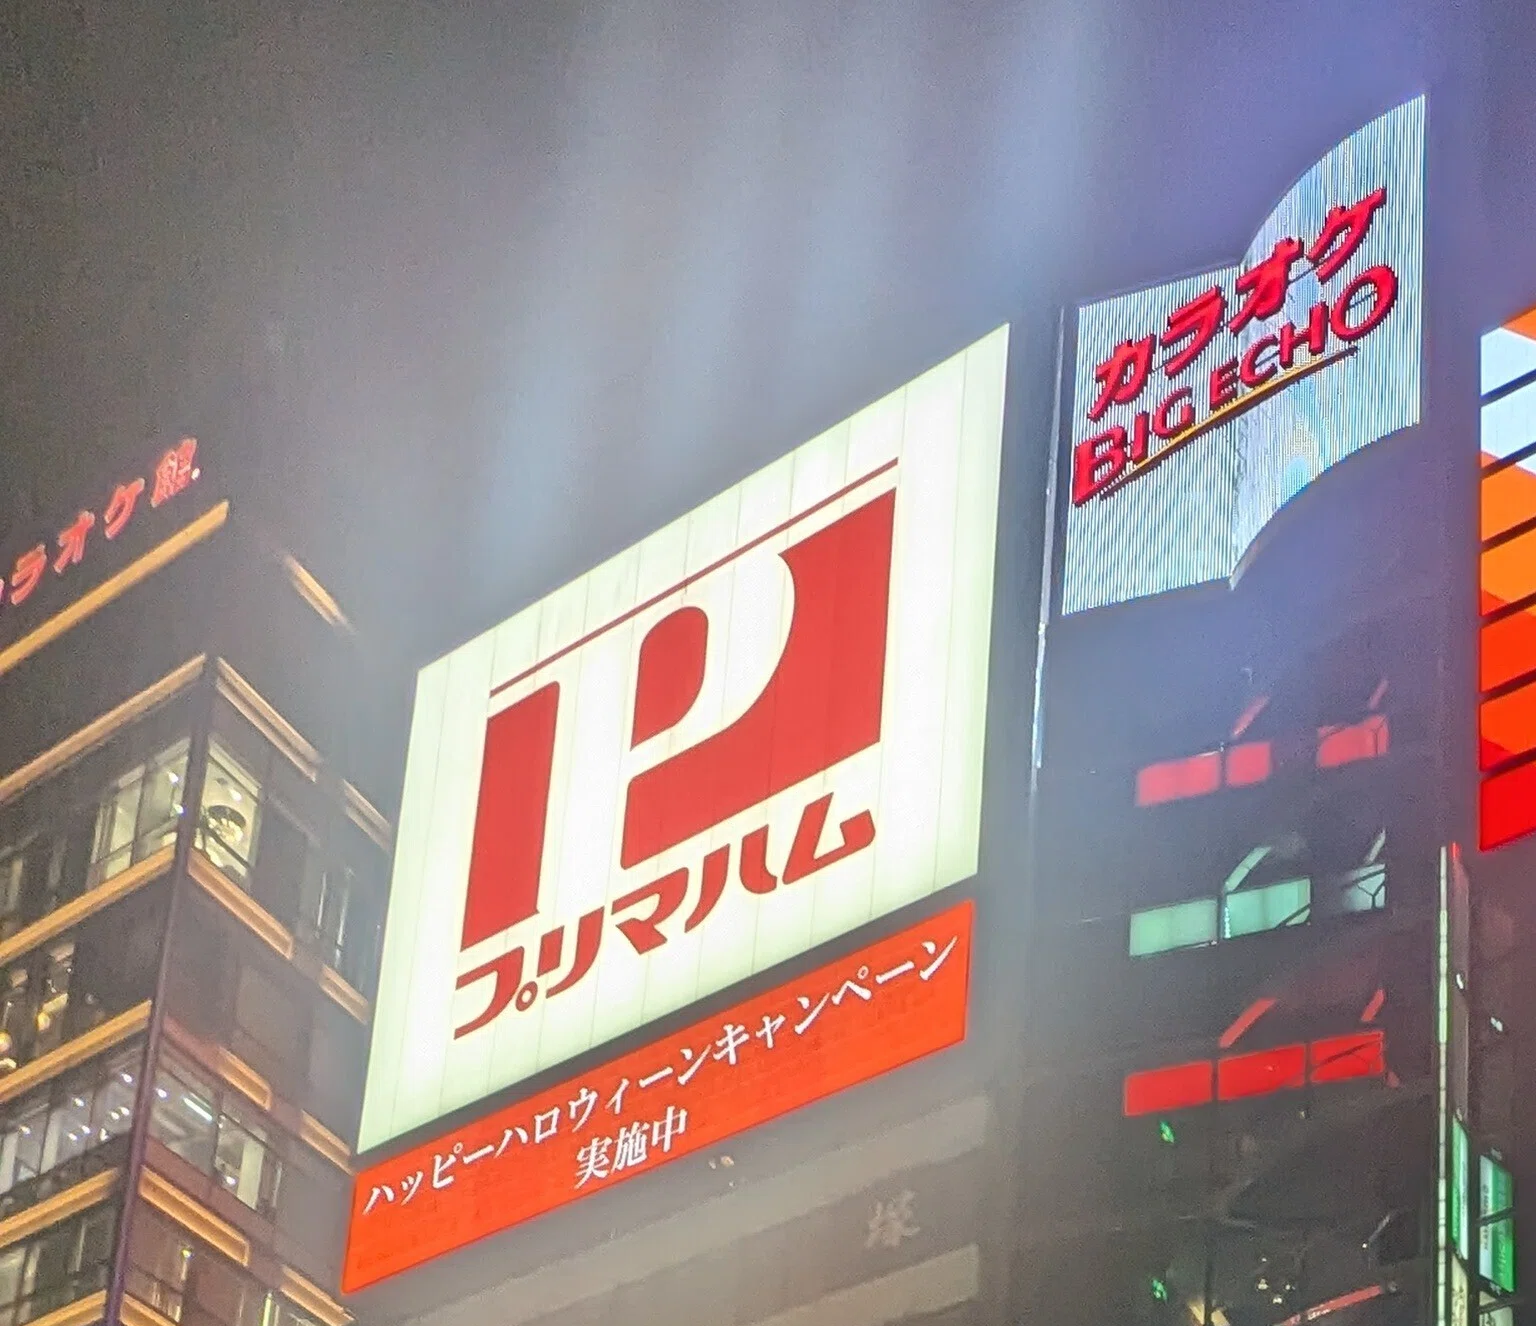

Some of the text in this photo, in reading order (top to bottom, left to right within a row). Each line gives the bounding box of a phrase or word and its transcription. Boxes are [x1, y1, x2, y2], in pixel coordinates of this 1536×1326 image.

[1071, 263, 1399, 507] BIG ECHO
[1087, 185, 1388, 422] カラオケ
[0, 437, 199, 606] ラオケ館
[452, 789, 876, 1041] プリマハム
[362, 932, 960, 1216] ハッピーハロウィーンキャンペーン
[572, 1106, 690, 1190] 実施中
